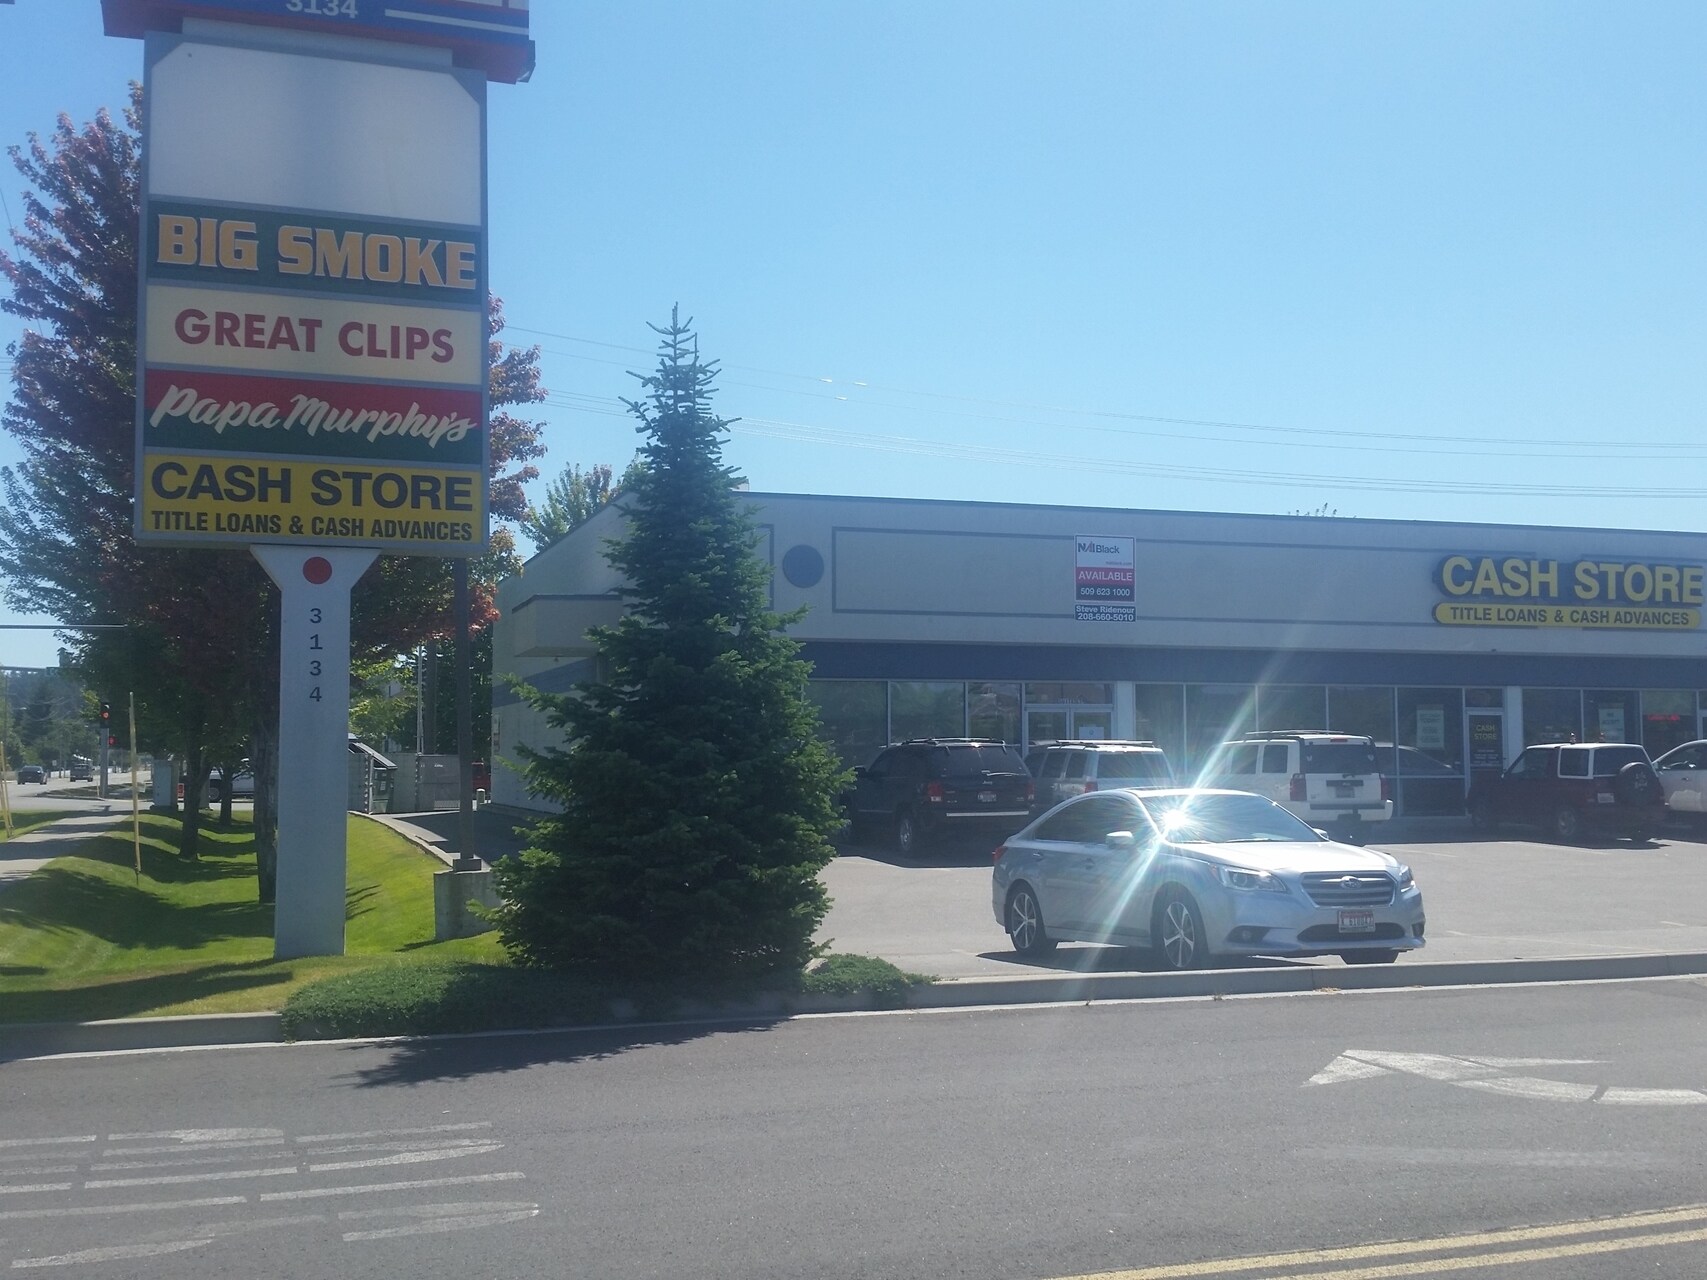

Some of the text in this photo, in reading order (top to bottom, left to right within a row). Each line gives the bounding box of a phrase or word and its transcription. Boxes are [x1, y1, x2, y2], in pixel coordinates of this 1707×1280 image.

[157, 213, 477, 290] BIG SMOKE
[174, 308, 455, 364] GREAT CLIPS
[150, 384, 477, 448] Papa Murphy's
[151, 461, 473, 512] CASH STORE
[152, 510, 473, 541] TITLE LOANS & CASH ADVANCES
[1078, 571, 1133, 582] AVAILABLE
[1080, 587, 1095, 596] 509
[1112, 588, 1131, 597] 1000
[1442, 556, 1704, 604] CASH STORE
[1450, 607, 1690, 626] TITLE LOANS & CASH ADVANCES
[309, 607, 323, 702] 3134
